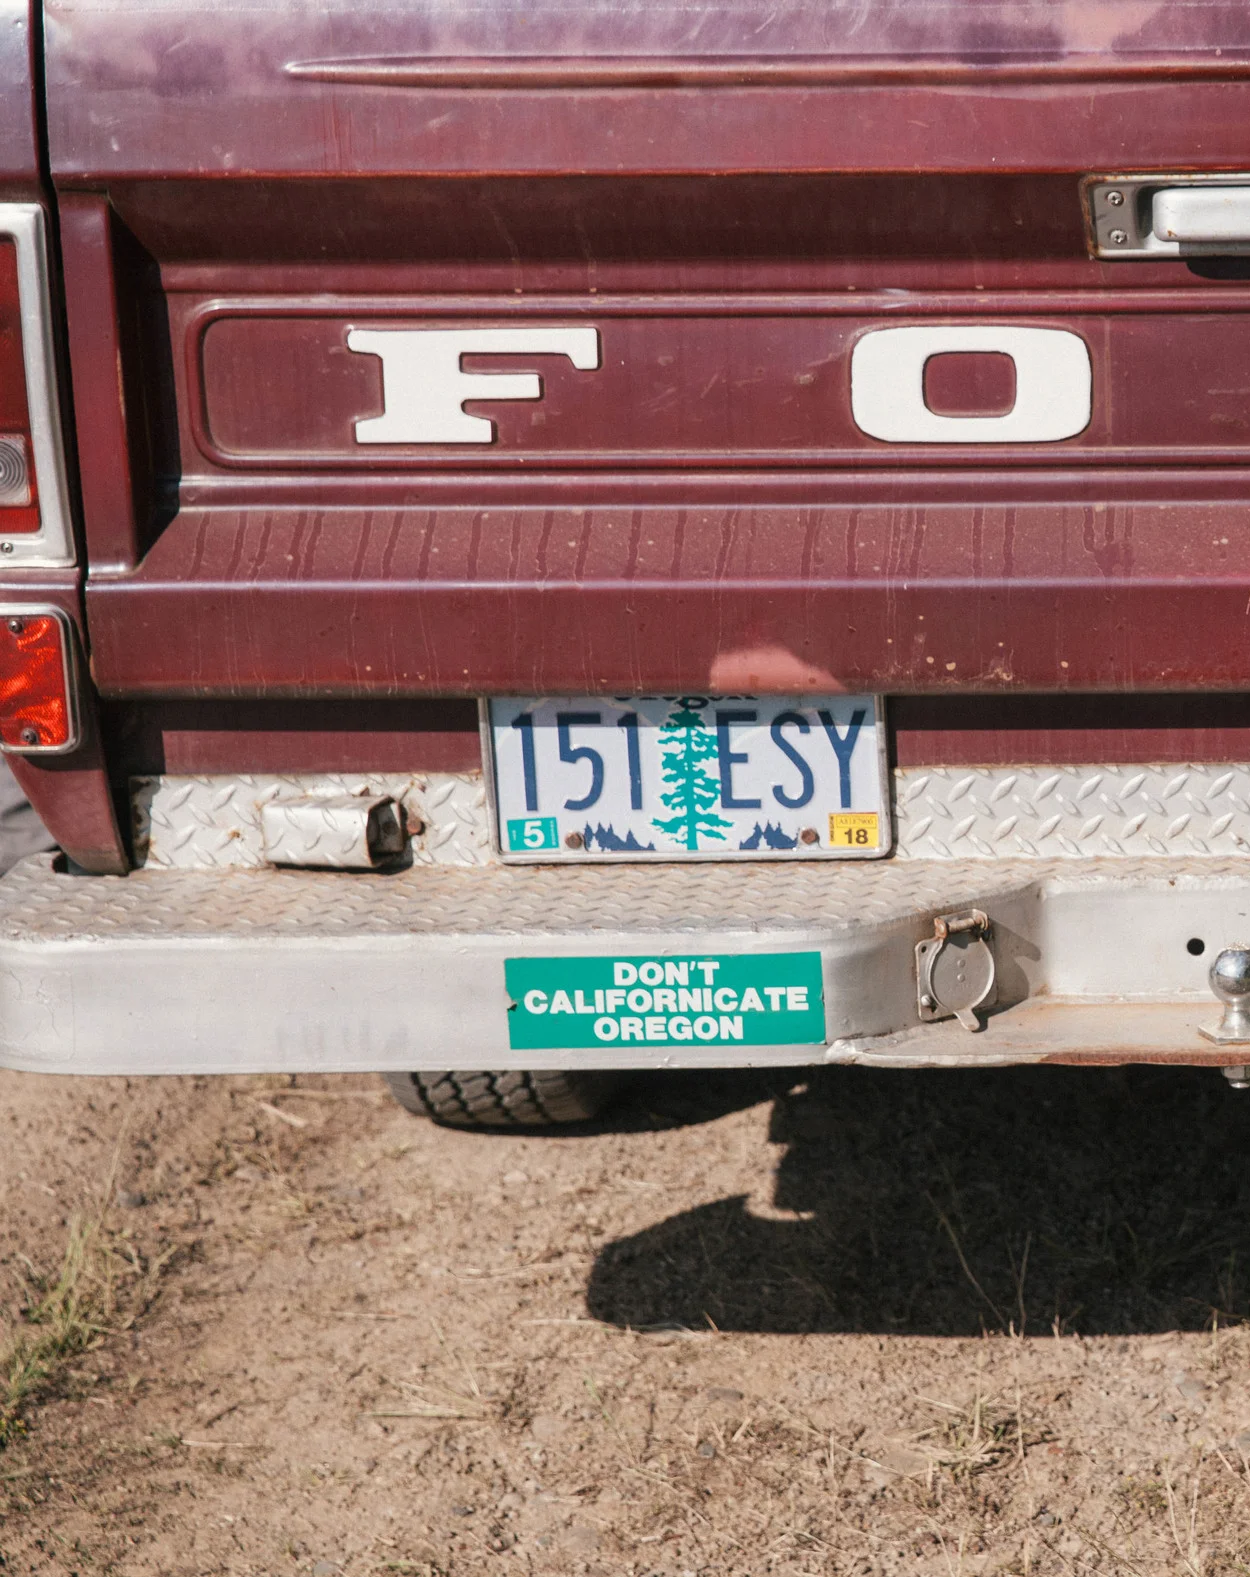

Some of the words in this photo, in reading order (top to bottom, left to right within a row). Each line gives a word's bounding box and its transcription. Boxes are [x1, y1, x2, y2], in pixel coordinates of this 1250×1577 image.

[511, 710, 643, 812] 151
[715, 709, 867, 810] ESY
[523, 820, 545, 848] 5
[844, 828, 869, 844] 18
[613, 961, 720, 986] DON'T
[524, 986, 809, 1014] CALIFORNICATE
[594, 1016, 743, 1041] OREGON
